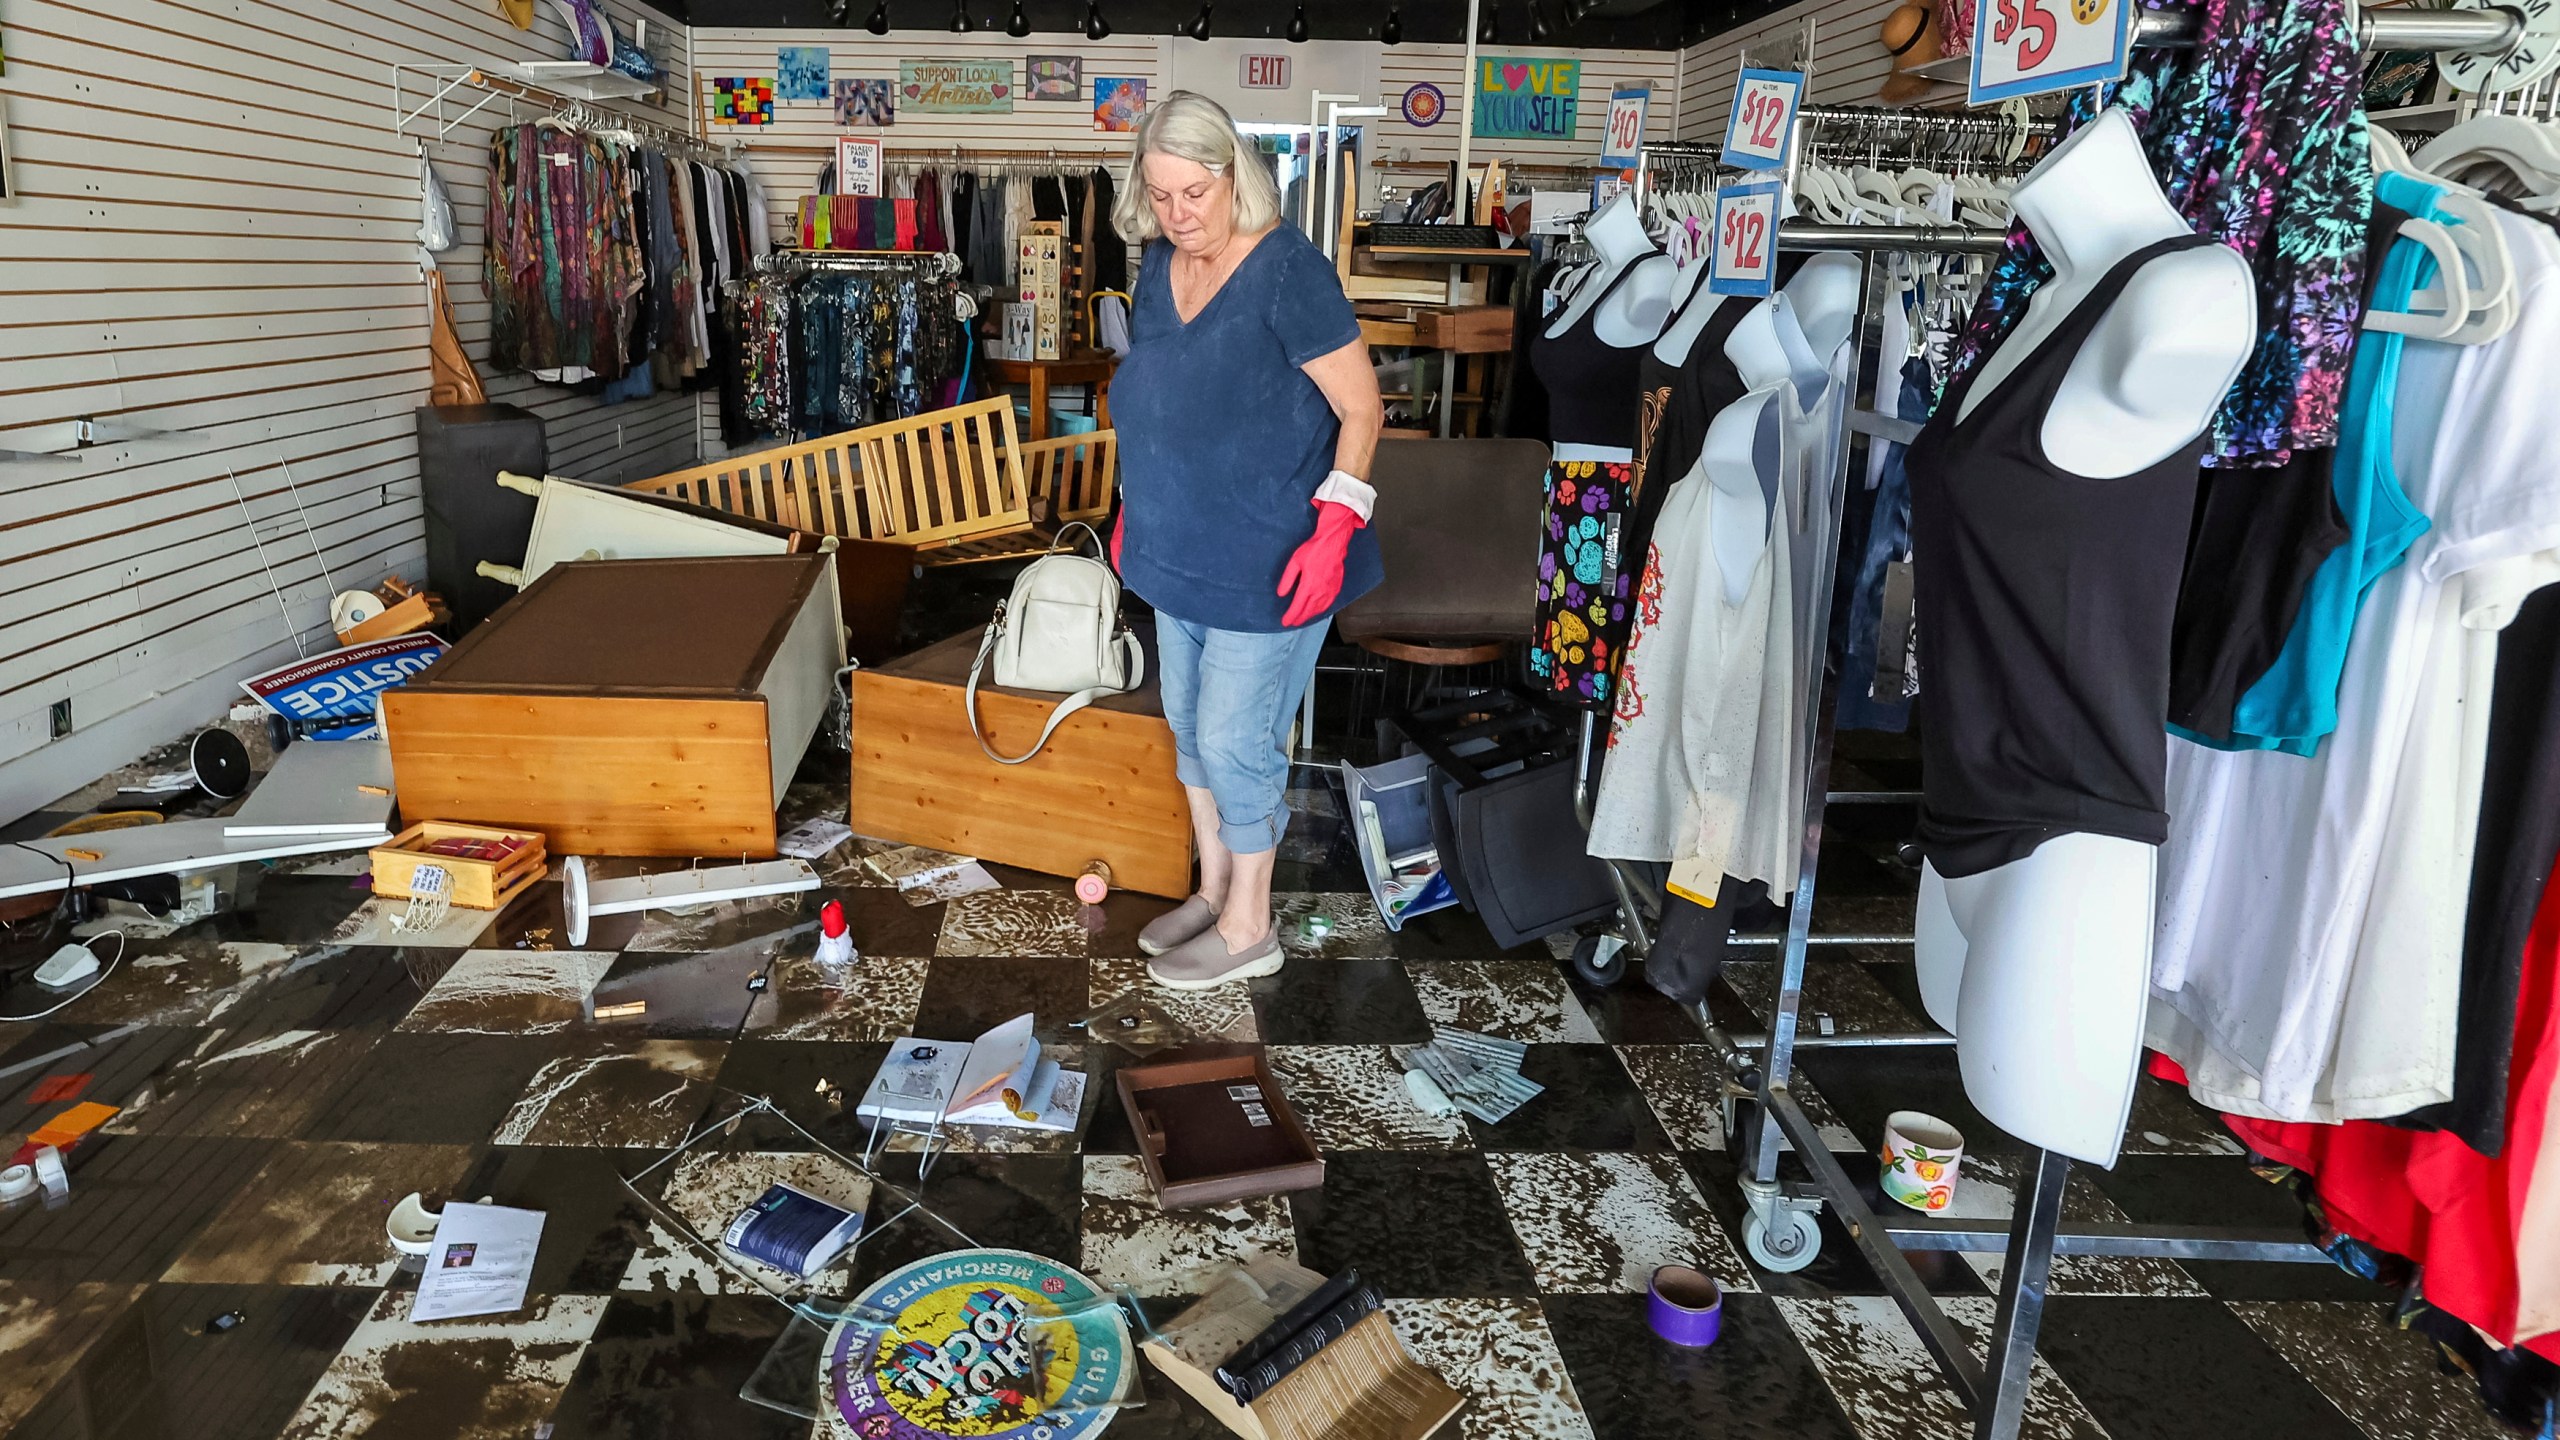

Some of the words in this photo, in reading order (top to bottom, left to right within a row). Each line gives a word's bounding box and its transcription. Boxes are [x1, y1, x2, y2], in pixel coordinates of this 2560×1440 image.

[1993, 0, 2058, 72] $5
[914, 66, 964, 83] SUPPORT
[965, 67, 1003, 84] LOCAL
[1248, 56, 1285, 86] EXIT
[918, 81, 994, 105] Artists
[1610, 104, 1639, 150] $10
[1742, 87, 1785, 149] $12
[852, 156, 869, 169] $15
[852, 182, 869, 195] $12
[1723, 205, 1765, 269] $12
[346, 645, 388, 663] COUNTY
[262, 656, 347, 690] COMMISSIONER
[880, 1260, 1034, 1310] MERCHANTS
[893, 1292, 1027, 1400] LOCAL
